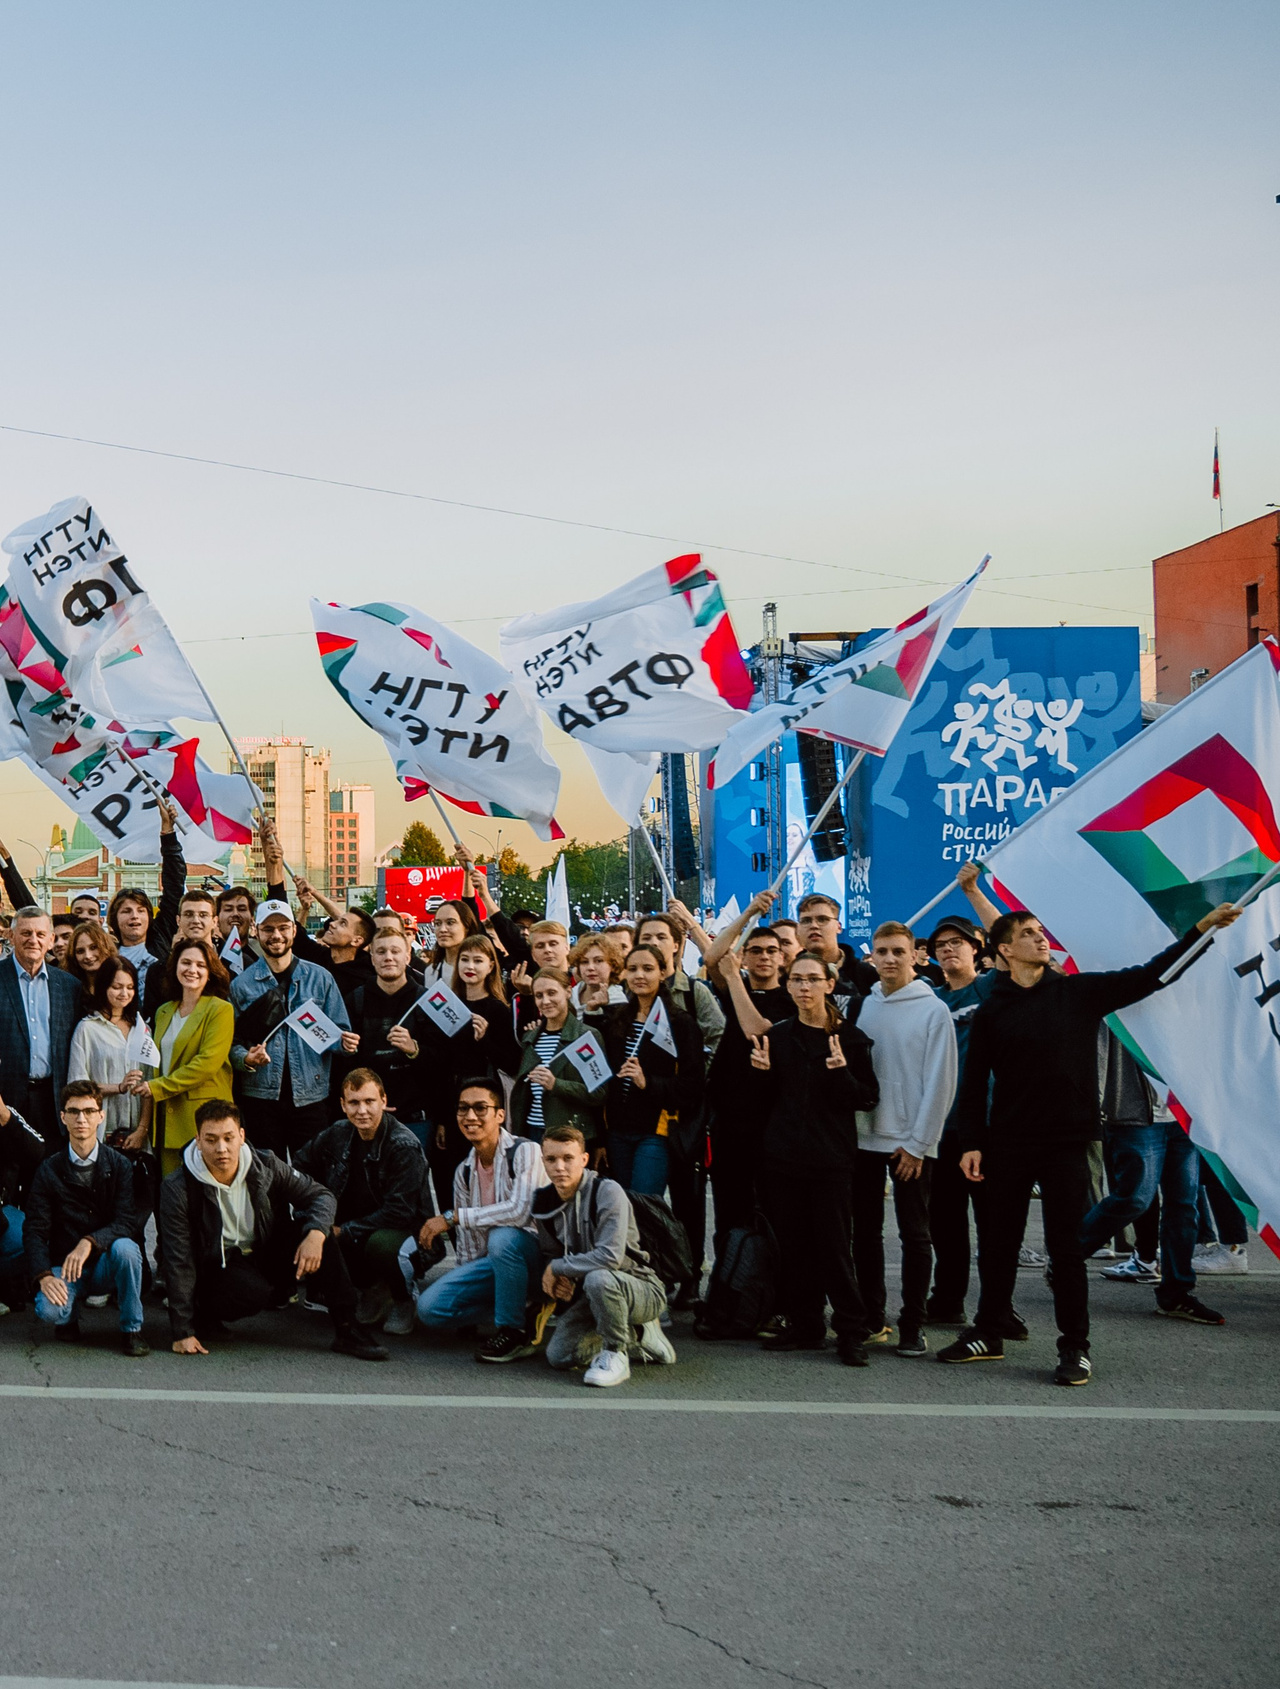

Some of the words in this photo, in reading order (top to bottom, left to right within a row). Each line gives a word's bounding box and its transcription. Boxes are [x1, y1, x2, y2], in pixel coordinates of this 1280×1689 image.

[23, 505, 92, 566] НГТУ
[32, 528, 111, 587] НЭТИ
[523, 622, 592, 677] НГТУ
[536, 642, 603, 698] НЭТИ
[369, 671, 509, 724] НГТУ
[558, 651, 695, 738] АВТФ
[365, 698, 510, 763] ЭТИ
[69, 759, 127, 800] НЭТ
[315, 1025, 330, 1039] НГТУ
